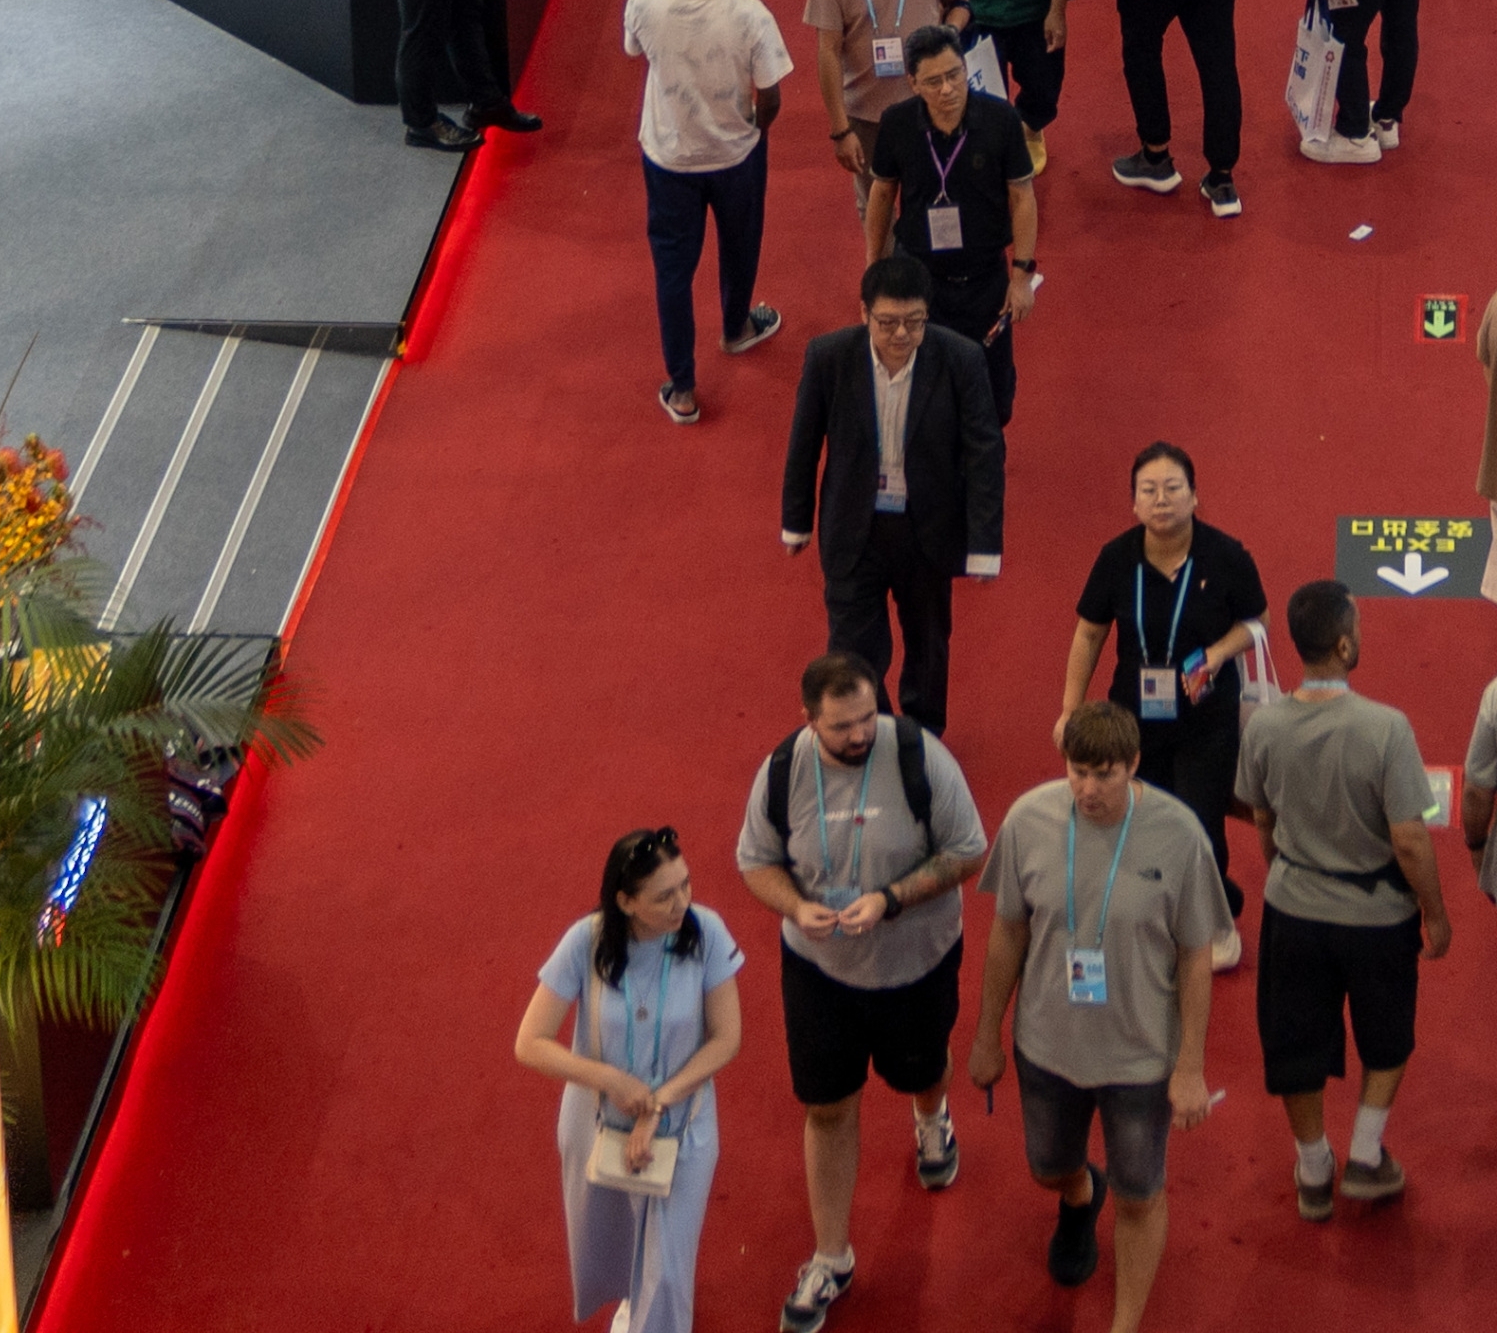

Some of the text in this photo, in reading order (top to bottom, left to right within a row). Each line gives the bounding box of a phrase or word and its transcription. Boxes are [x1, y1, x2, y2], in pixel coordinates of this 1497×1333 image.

[1350, 519, 1474, 538] 安全出口
[1369, 536, 1456, 554] EXIT
